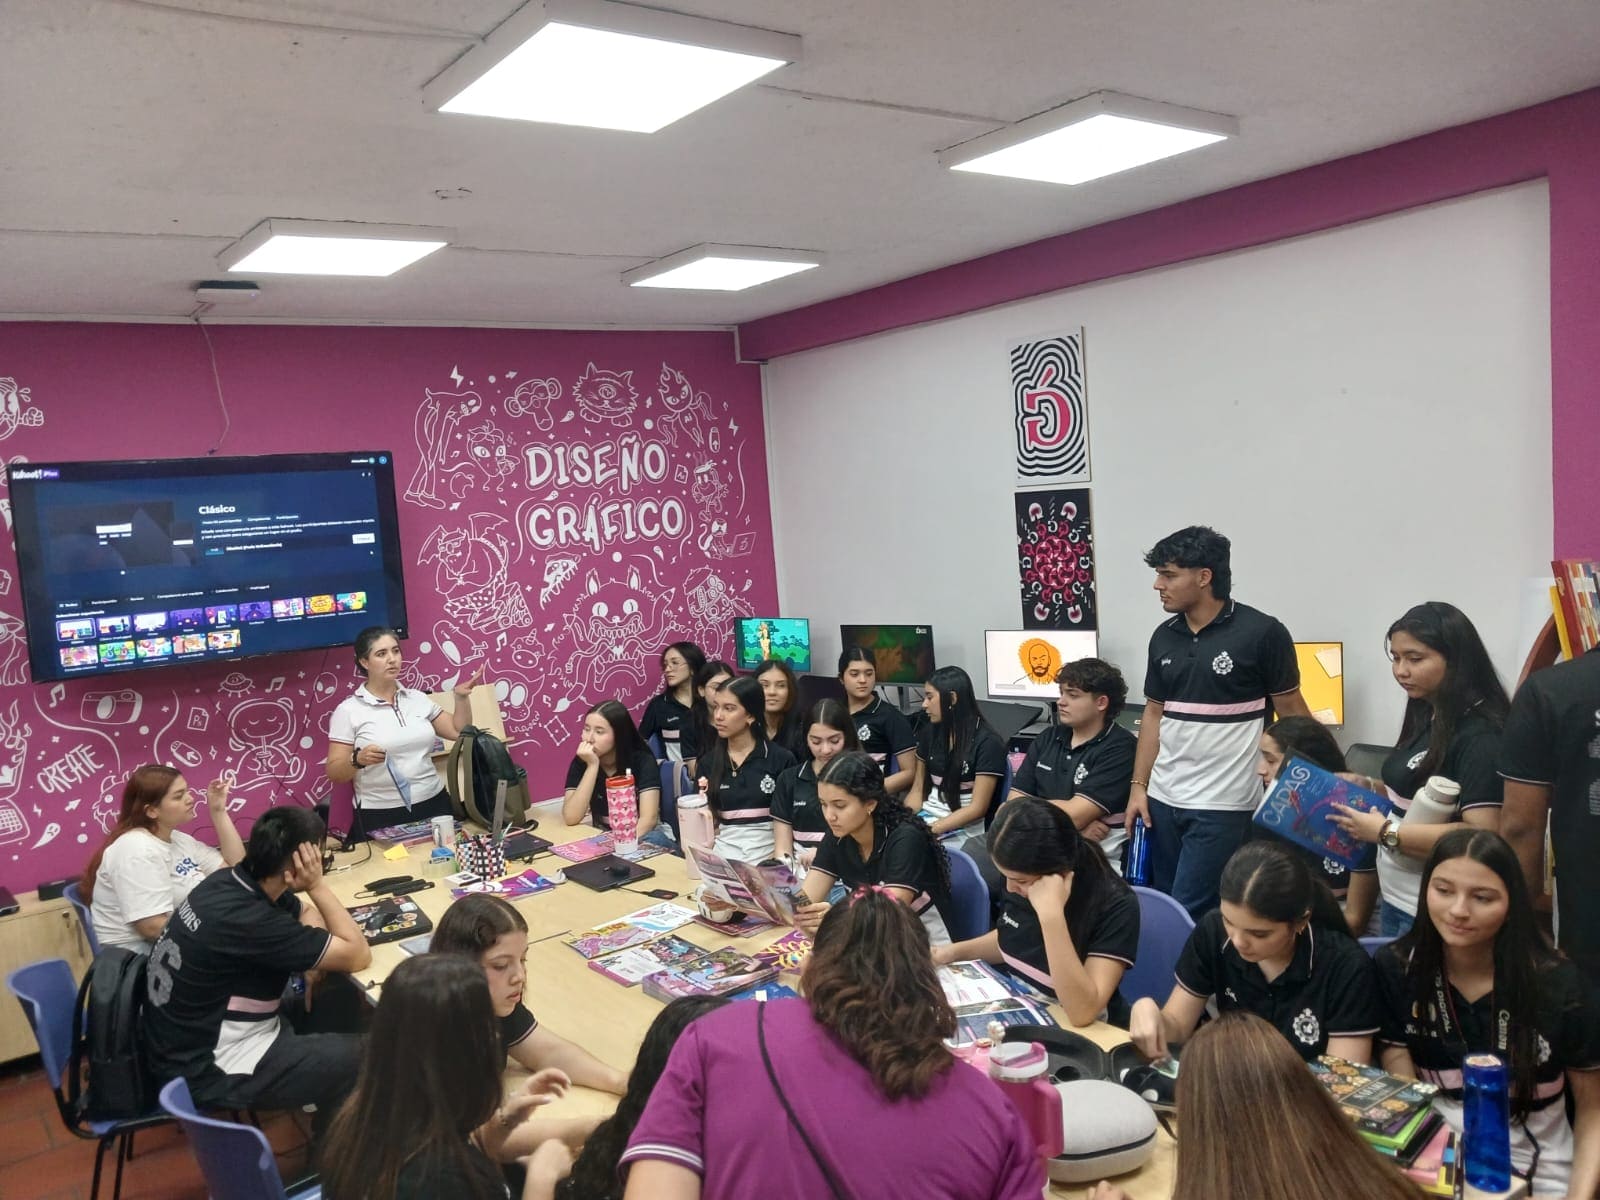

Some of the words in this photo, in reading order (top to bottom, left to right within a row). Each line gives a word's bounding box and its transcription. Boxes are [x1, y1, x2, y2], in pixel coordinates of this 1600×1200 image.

[525, 435, 666, 491] DISEÑO
[199, 504, 236, 515] Clásico
[528, 497, 684, 551] GRÁFICO
[37, 743, 105, 793] CREATE
[1436, 991, 1452, 1033] DIGITAL
[1498, 1009, 1510, 1050] Canon
